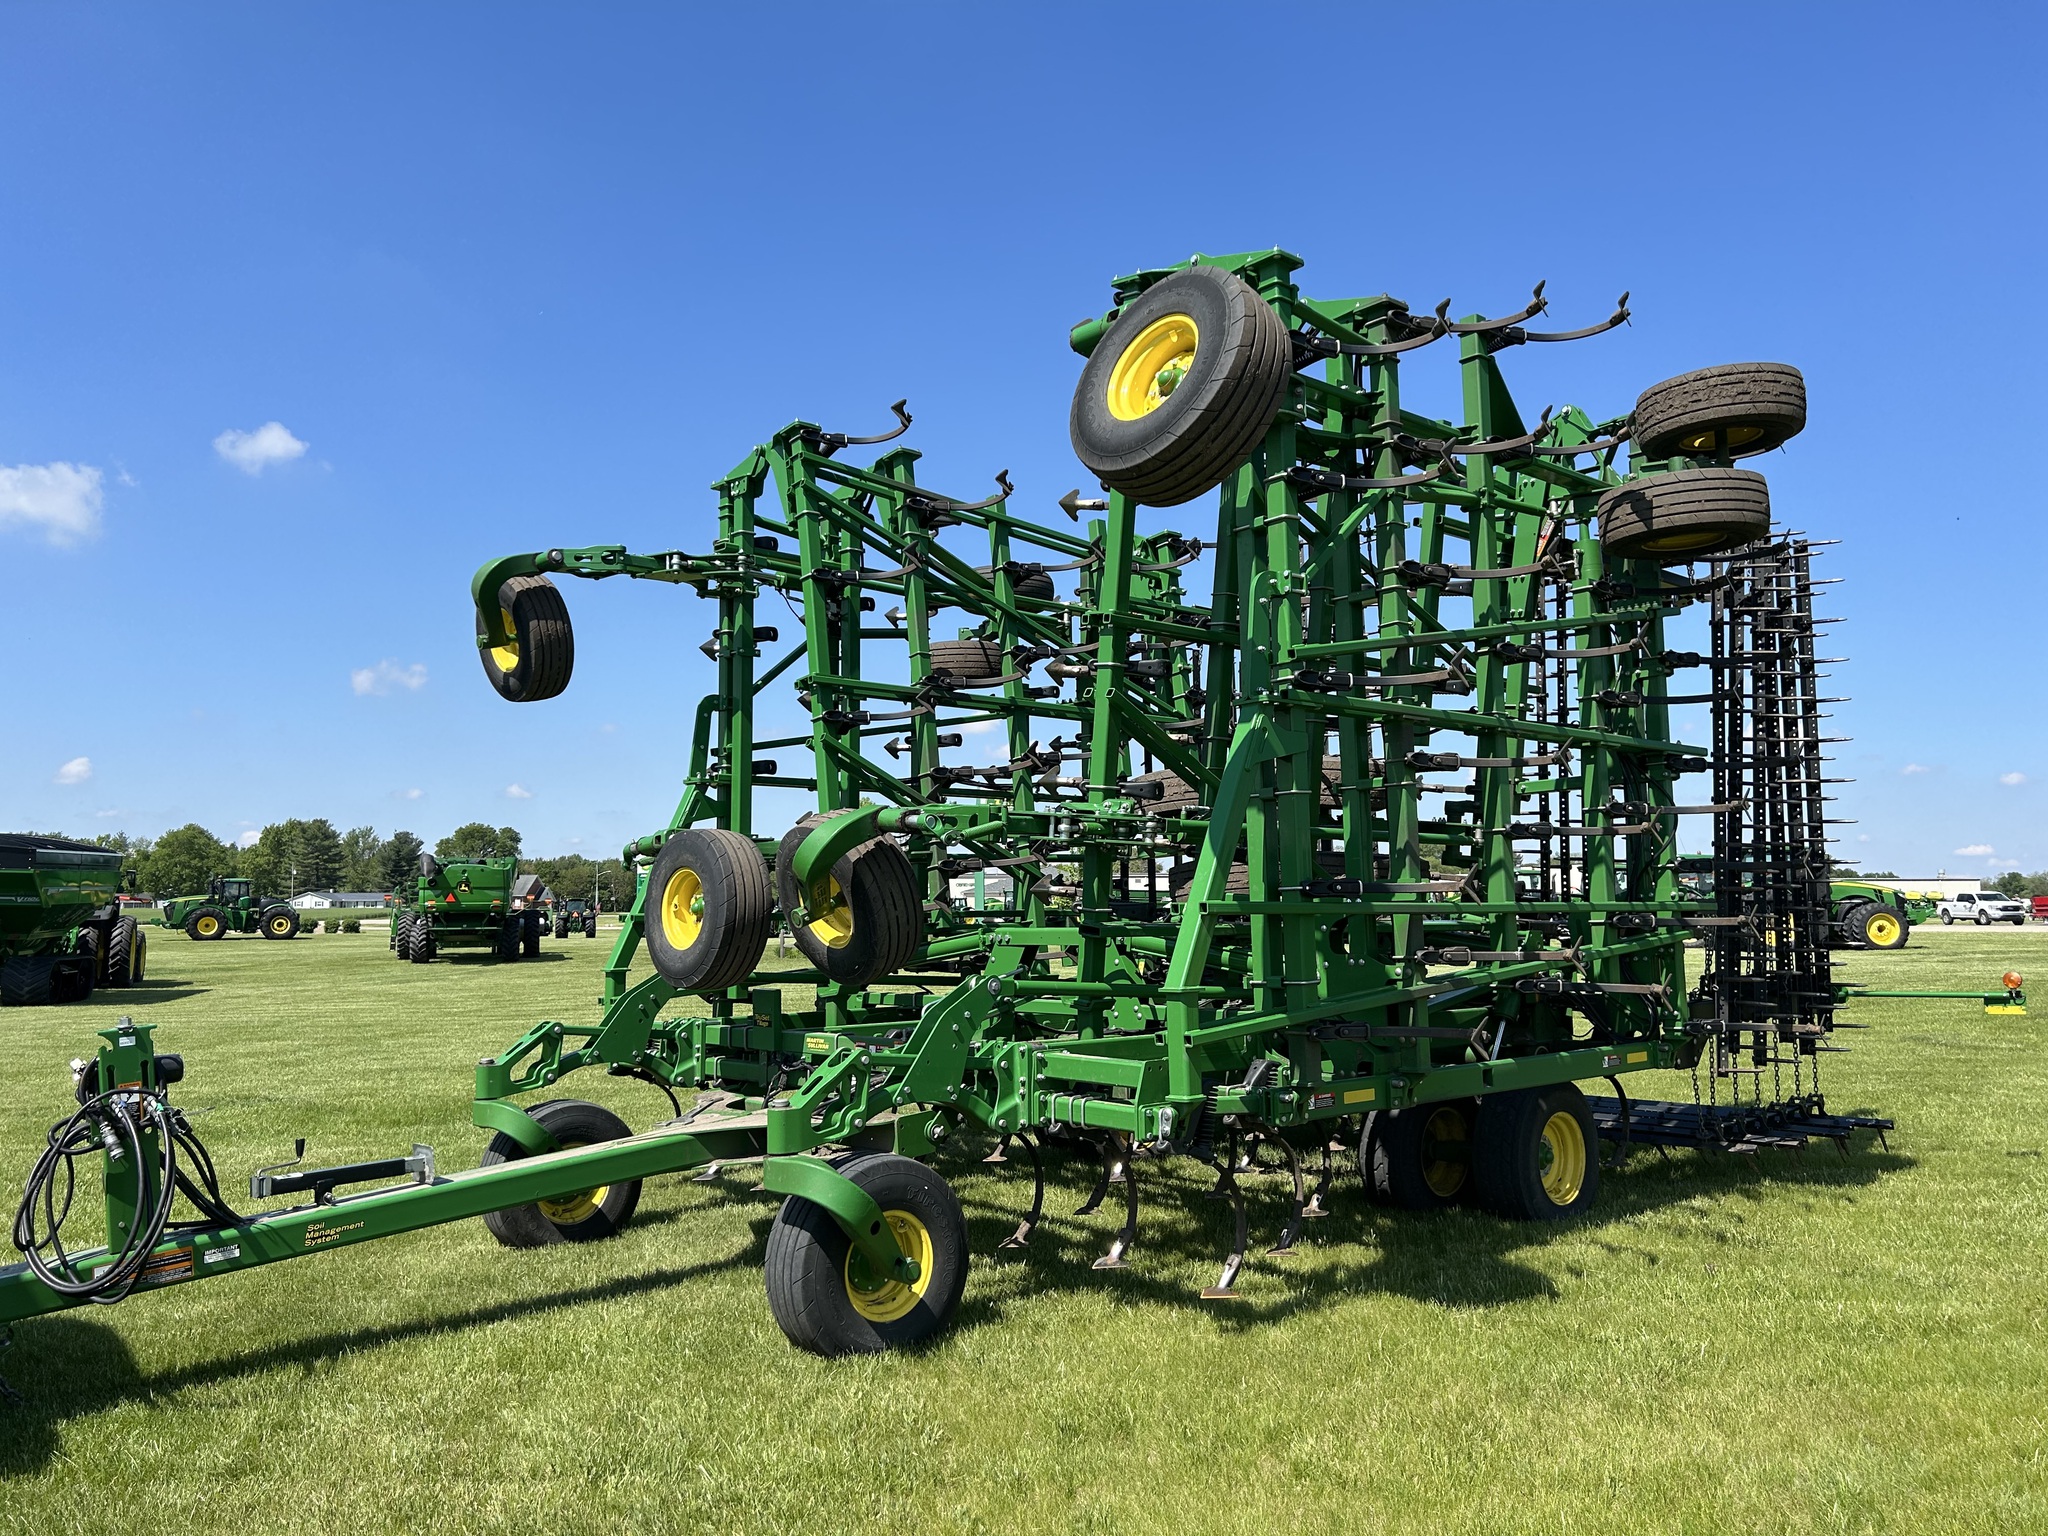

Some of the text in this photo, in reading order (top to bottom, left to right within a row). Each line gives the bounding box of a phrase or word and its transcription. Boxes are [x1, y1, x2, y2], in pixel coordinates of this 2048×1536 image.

[305, 1220, 365, 1240] Management
[307, 1221, 325, 1232] Soil
[304, 1233, 340, 1247] System
[907, 1184, 956, 1286] Firestone
[204, 1243, 239, 1256] IMPORTANT
